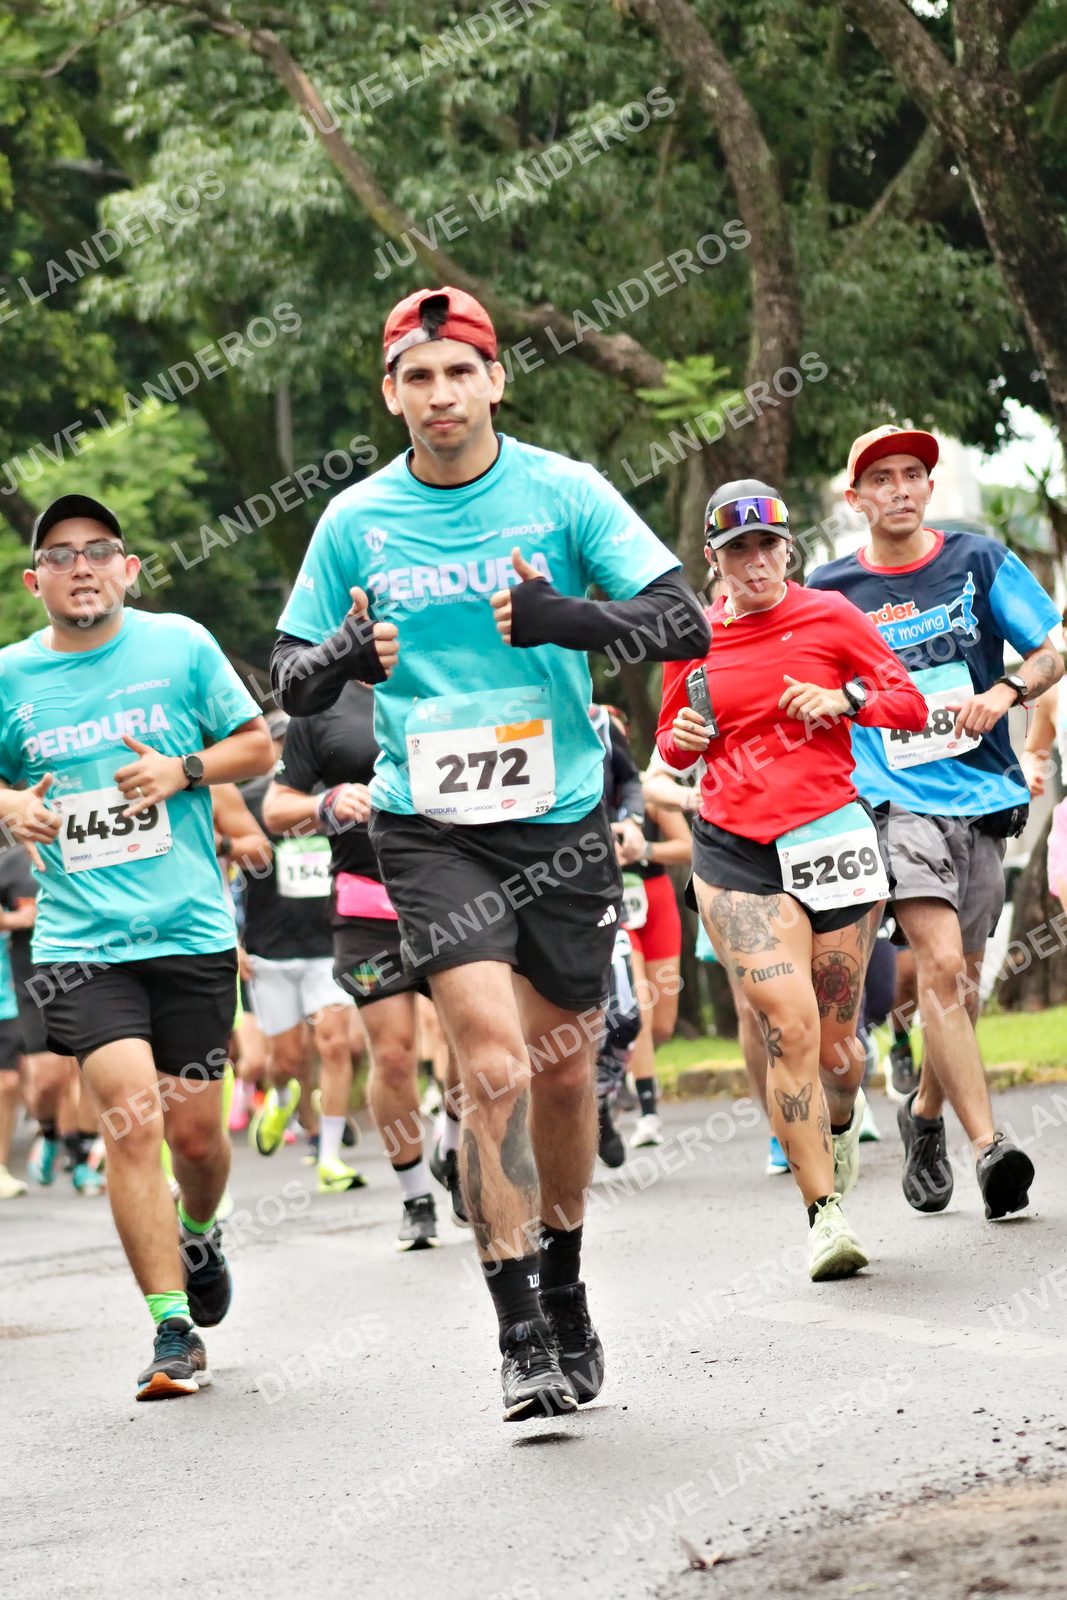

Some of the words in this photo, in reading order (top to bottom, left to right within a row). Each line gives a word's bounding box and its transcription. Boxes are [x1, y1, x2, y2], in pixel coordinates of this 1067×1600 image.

[501, 521, 555, 538] BROOKS
[368, 553, 554, 600] PERDURA
[868, 602, 915, 625] nder
[899, 615, 945, 641] moving
[126, 678, 171, 694] BROOKS
[24, 703, 171, 762] PERDURA
[435, 747, 530, 794] 272
[66, 803, 159, 844] 4439
[425, 807, 457, 815] PERDURA
[791, 846, 878, 899] 5269
